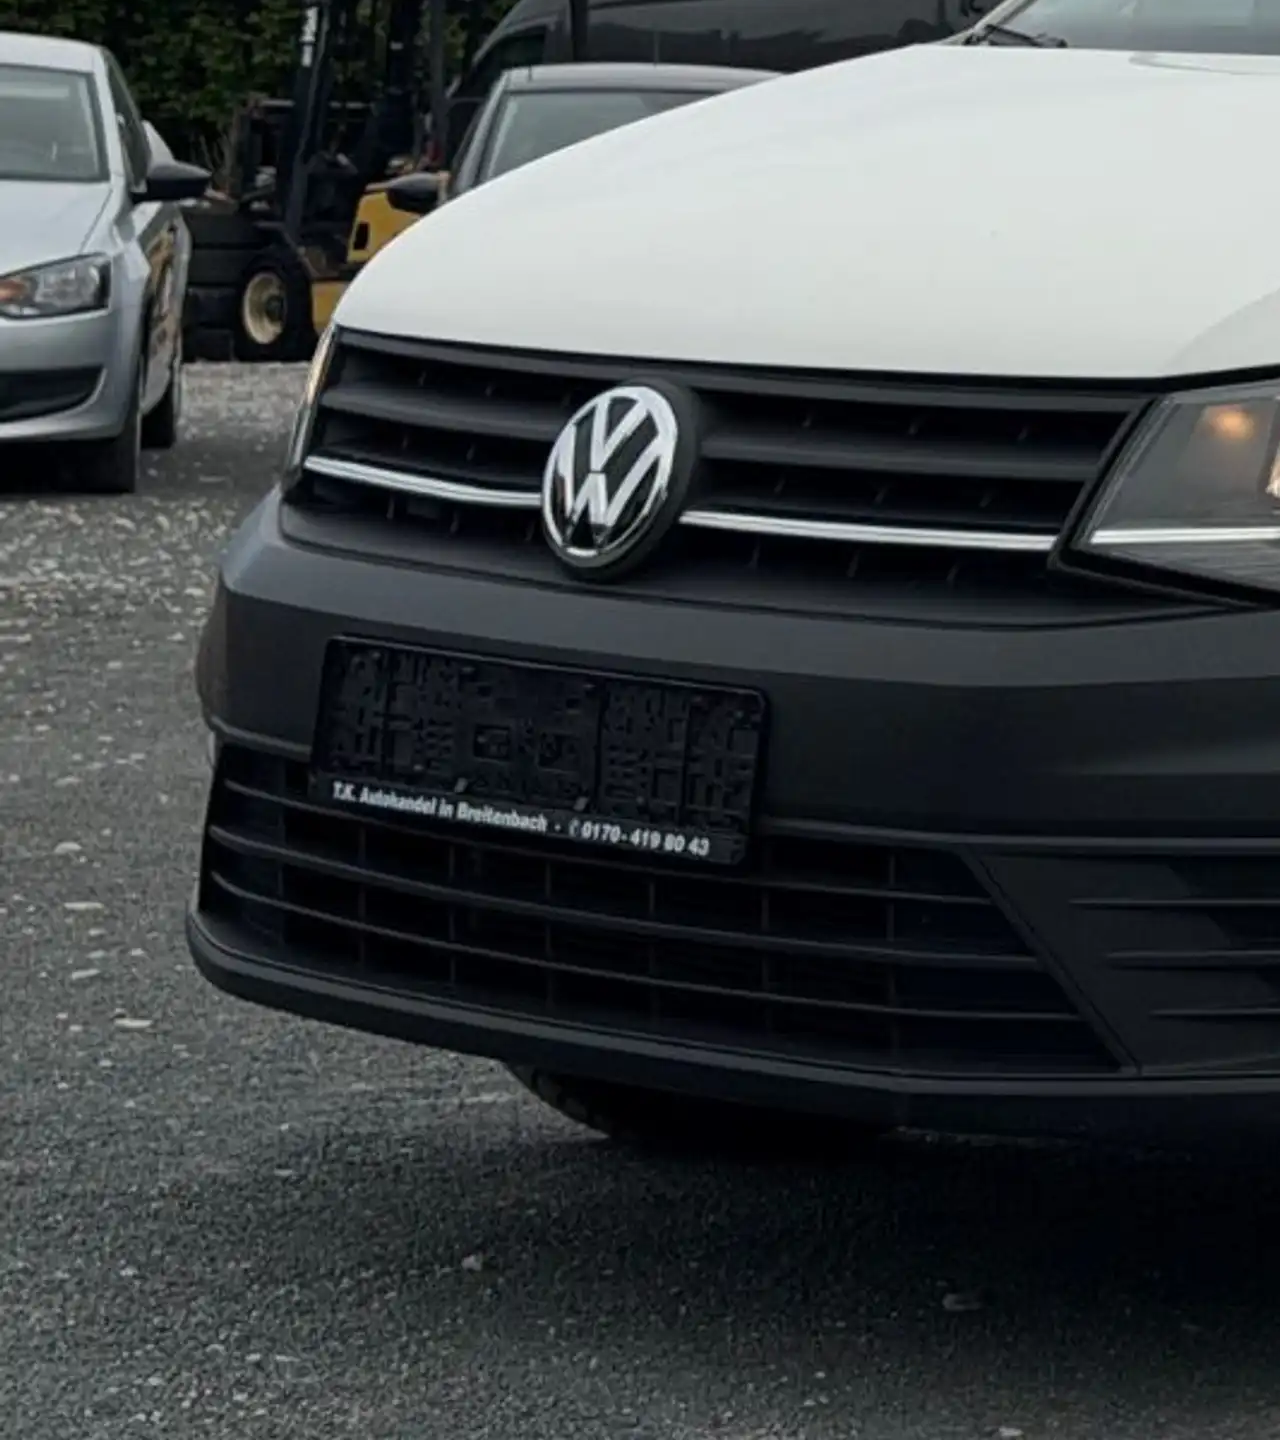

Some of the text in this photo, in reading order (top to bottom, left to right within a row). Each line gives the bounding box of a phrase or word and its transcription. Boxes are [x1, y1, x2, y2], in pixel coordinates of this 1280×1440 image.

[543, 386, 677, 557] VW
[332, 780, 357, 802] T.K.
[359, 786, 436, 816] Autohandel
[438, 796, 454, 819] in
[456, 800, 548, 833] Breitenbach
[687, 835, 710, 857] 43
